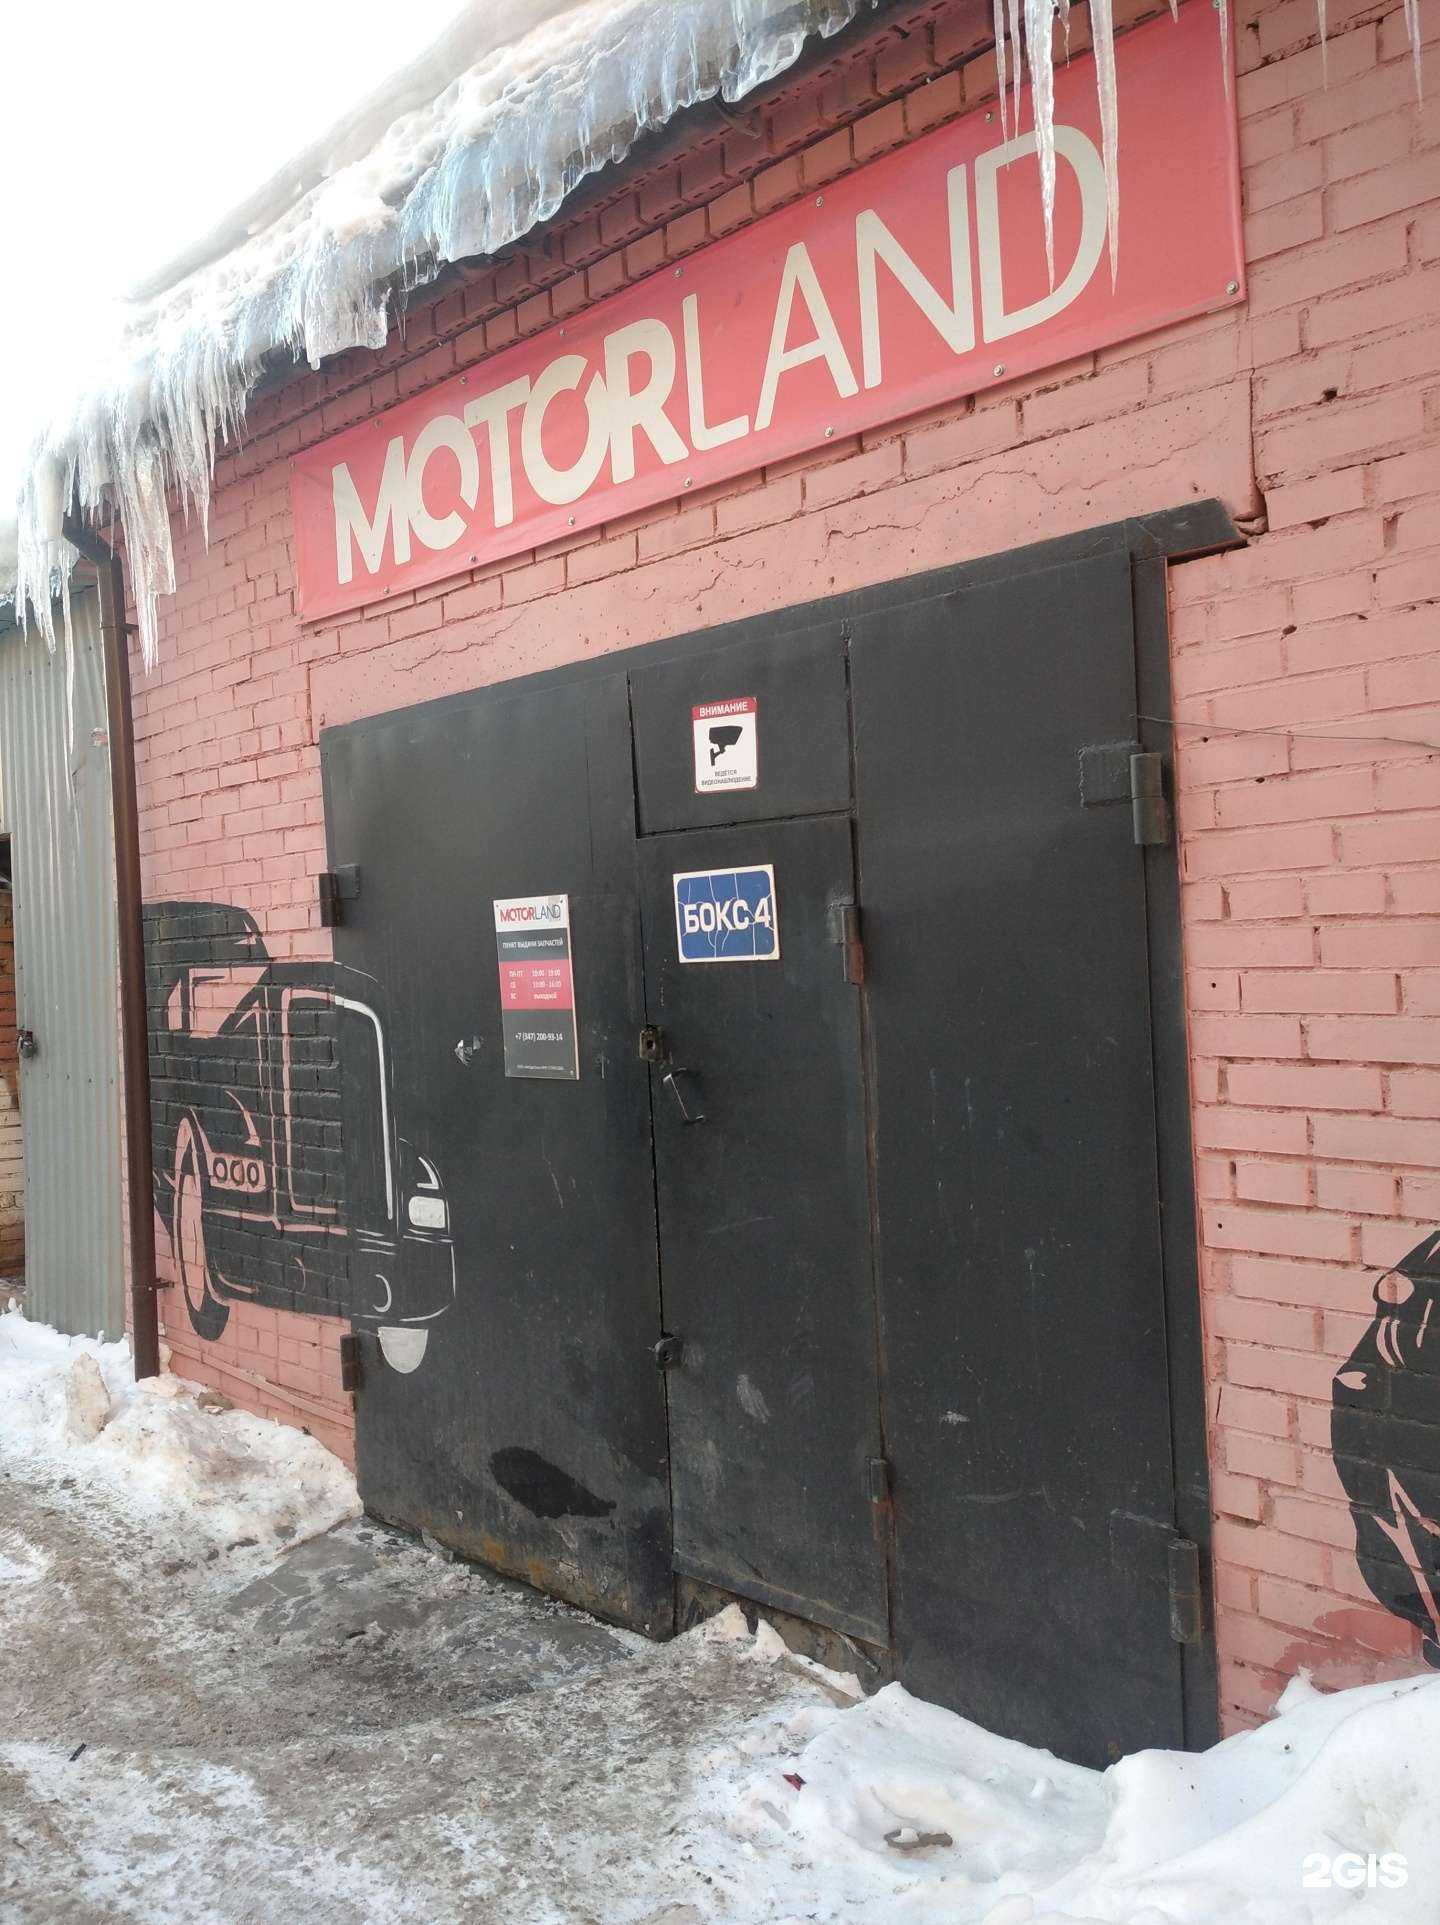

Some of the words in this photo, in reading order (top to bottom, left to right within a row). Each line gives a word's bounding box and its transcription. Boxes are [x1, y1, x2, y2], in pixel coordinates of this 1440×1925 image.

[332, 122, 1106, 584] MOTORLAND
[699, 701, 749, 717] ВНИМАНИЕ
[500, 904, 561, 922] MOTORLAND
[502, 941, 517, 949] ПУНКТ
[517, 940, 537, 949] ВЫДАЧИ
[537, 937, 564, 948] ЗАПЧАСТЕЙ
[515, 1032, 521, 1040] +7
